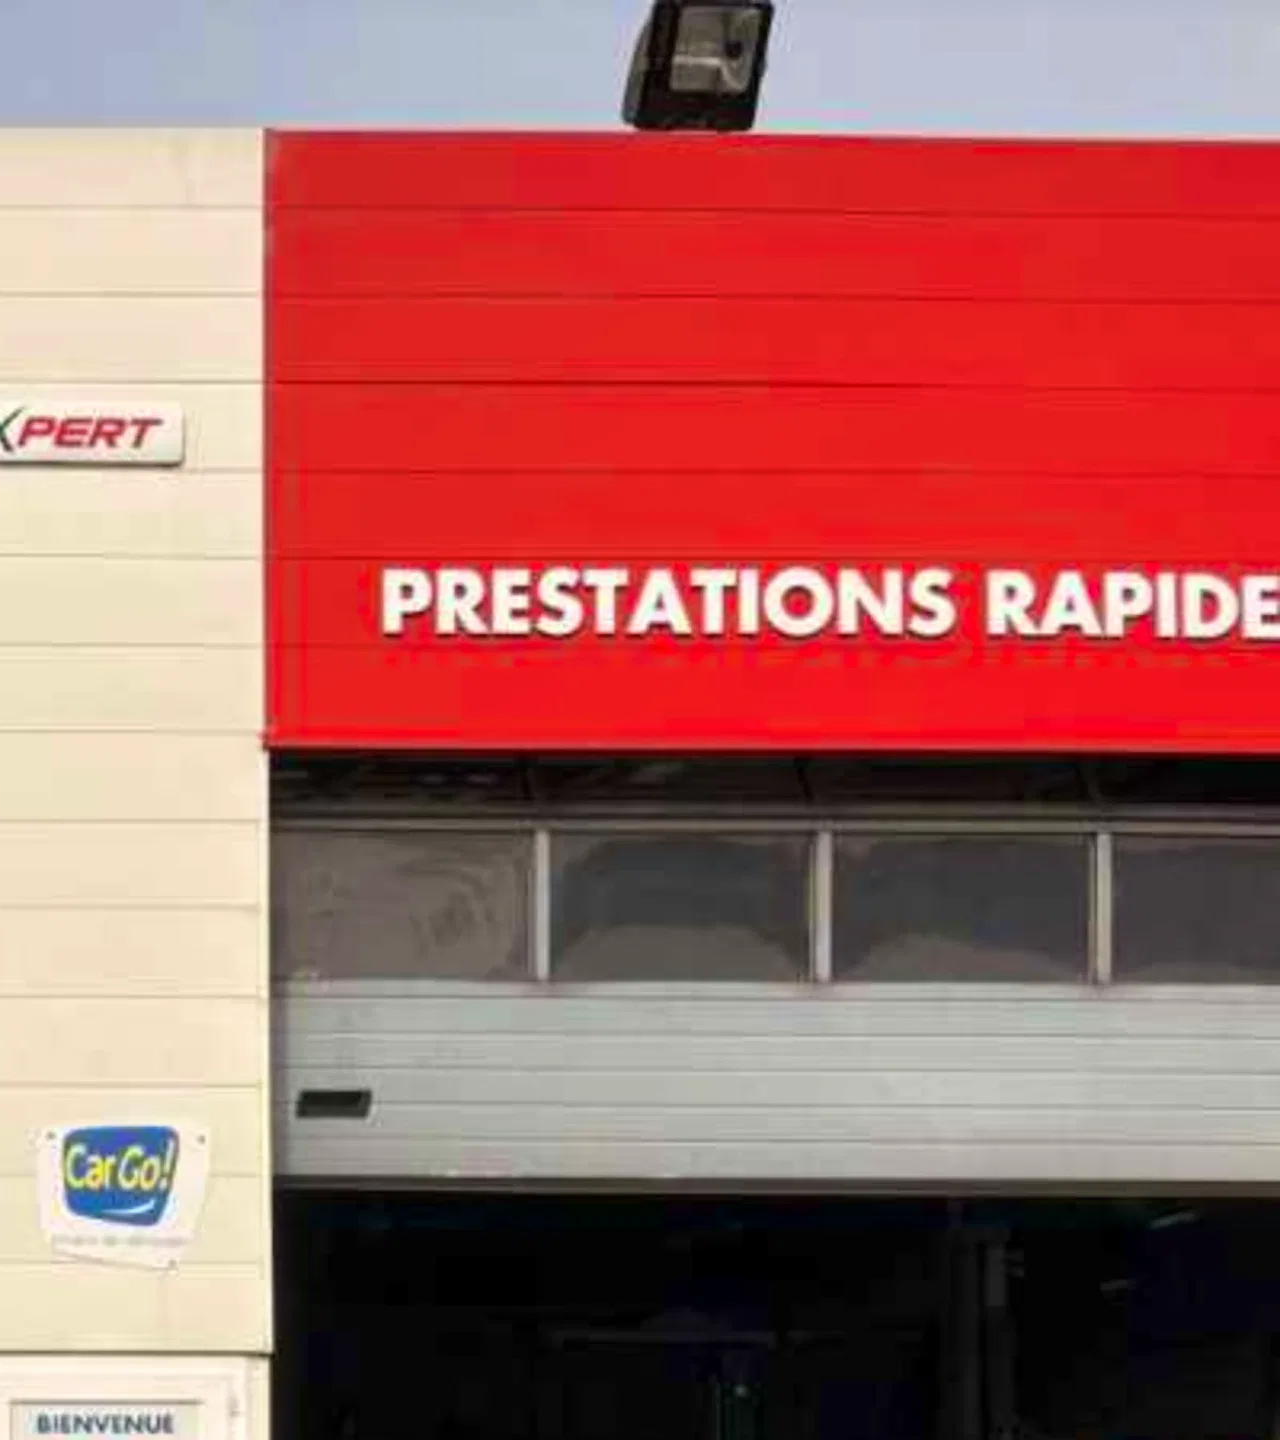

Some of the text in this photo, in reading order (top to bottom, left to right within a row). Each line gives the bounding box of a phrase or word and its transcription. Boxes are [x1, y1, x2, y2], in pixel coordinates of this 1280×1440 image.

[381, 567, 1280, 639] PRESTATIONS RAPIDE
[35, 1413, 175, 1435] BIENVENUE
